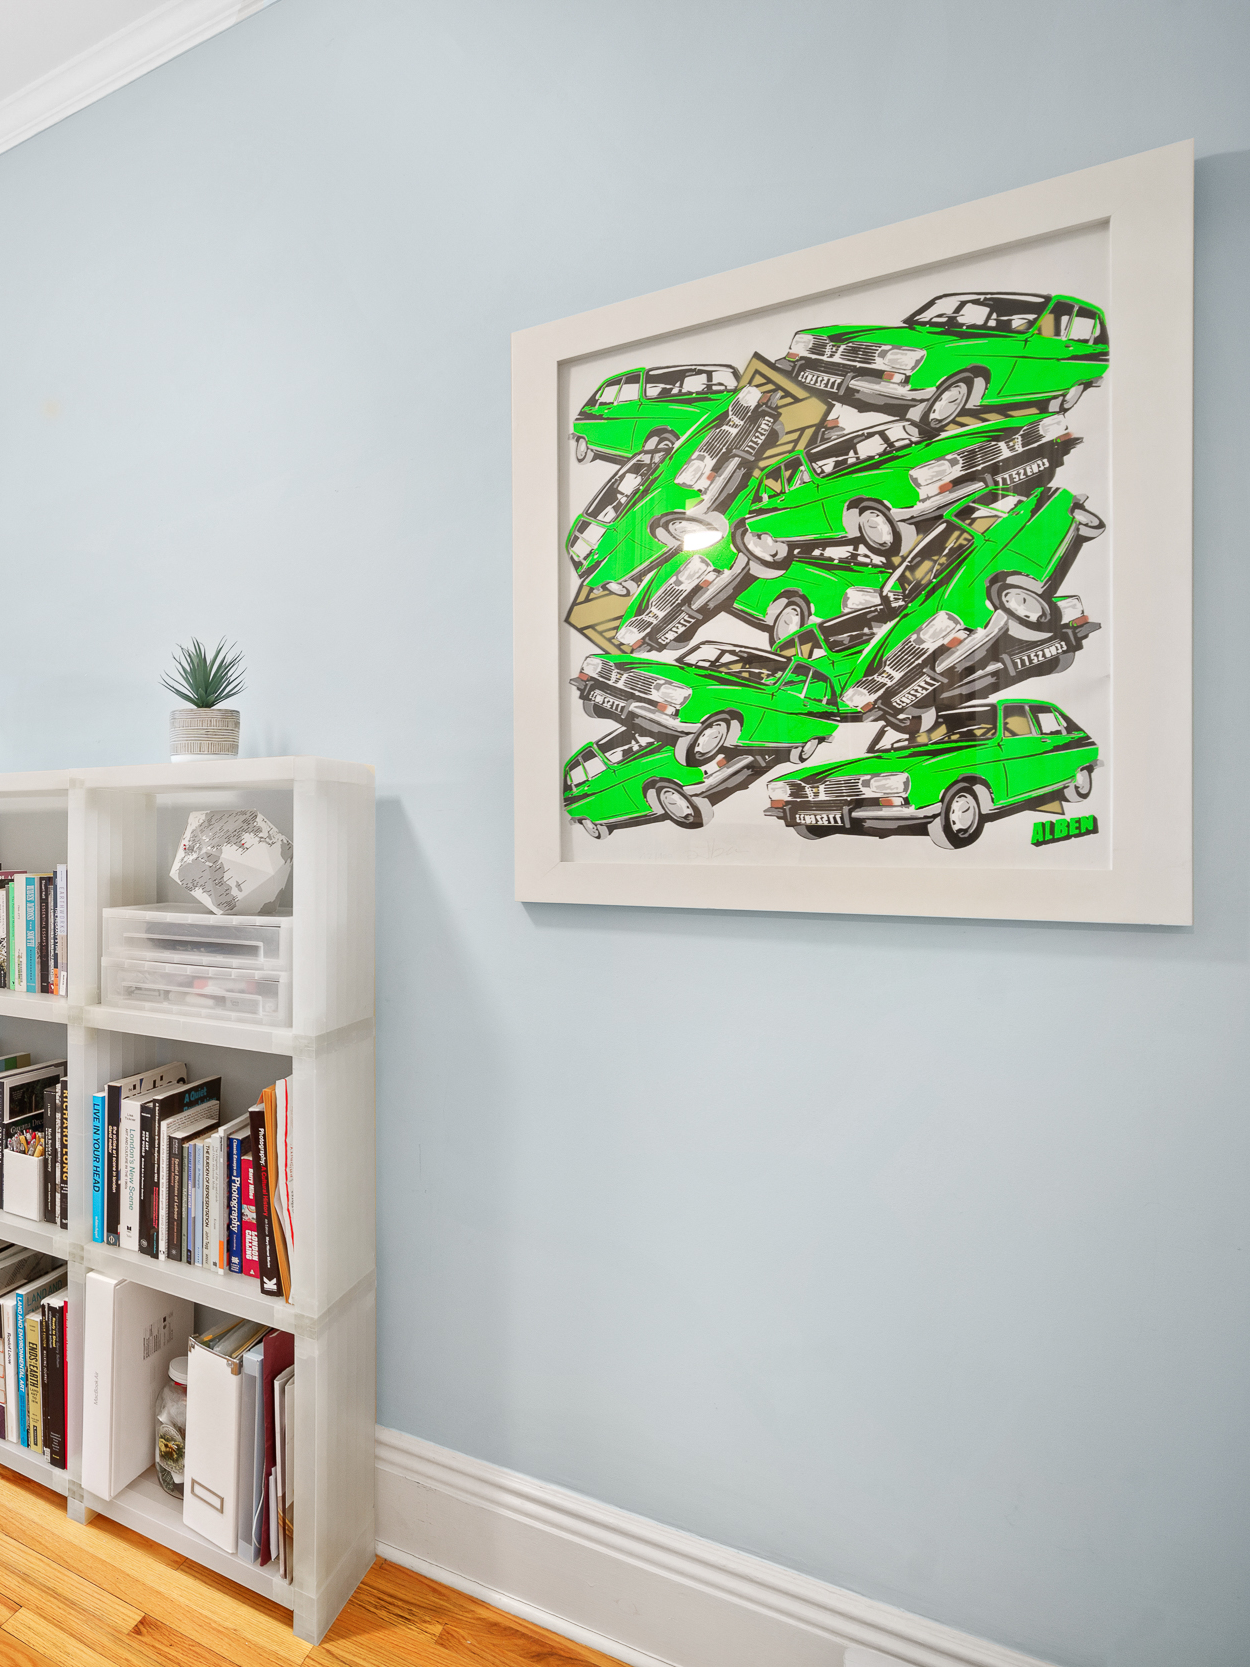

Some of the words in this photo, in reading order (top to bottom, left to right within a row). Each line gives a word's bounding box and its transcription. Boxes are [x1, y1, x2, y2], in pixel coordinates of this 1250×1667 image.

[1031, 814, 1098, 846] ALBEN
[26, 931, 34, 947] SOUTH
[184, 1093, 189, 1103] A
[190, 1086, 207, 1100] Quiet
[93, 1125, 100, 1136] IN
[230, 1176, 240, 1232] Photography
[27, 1290, 47, 1306] LAND
[48, 1280, 62, 1295] AND
[29, 1341, 37, 1360] ENDS
[30, 1364, 38, 1388] EARTH
